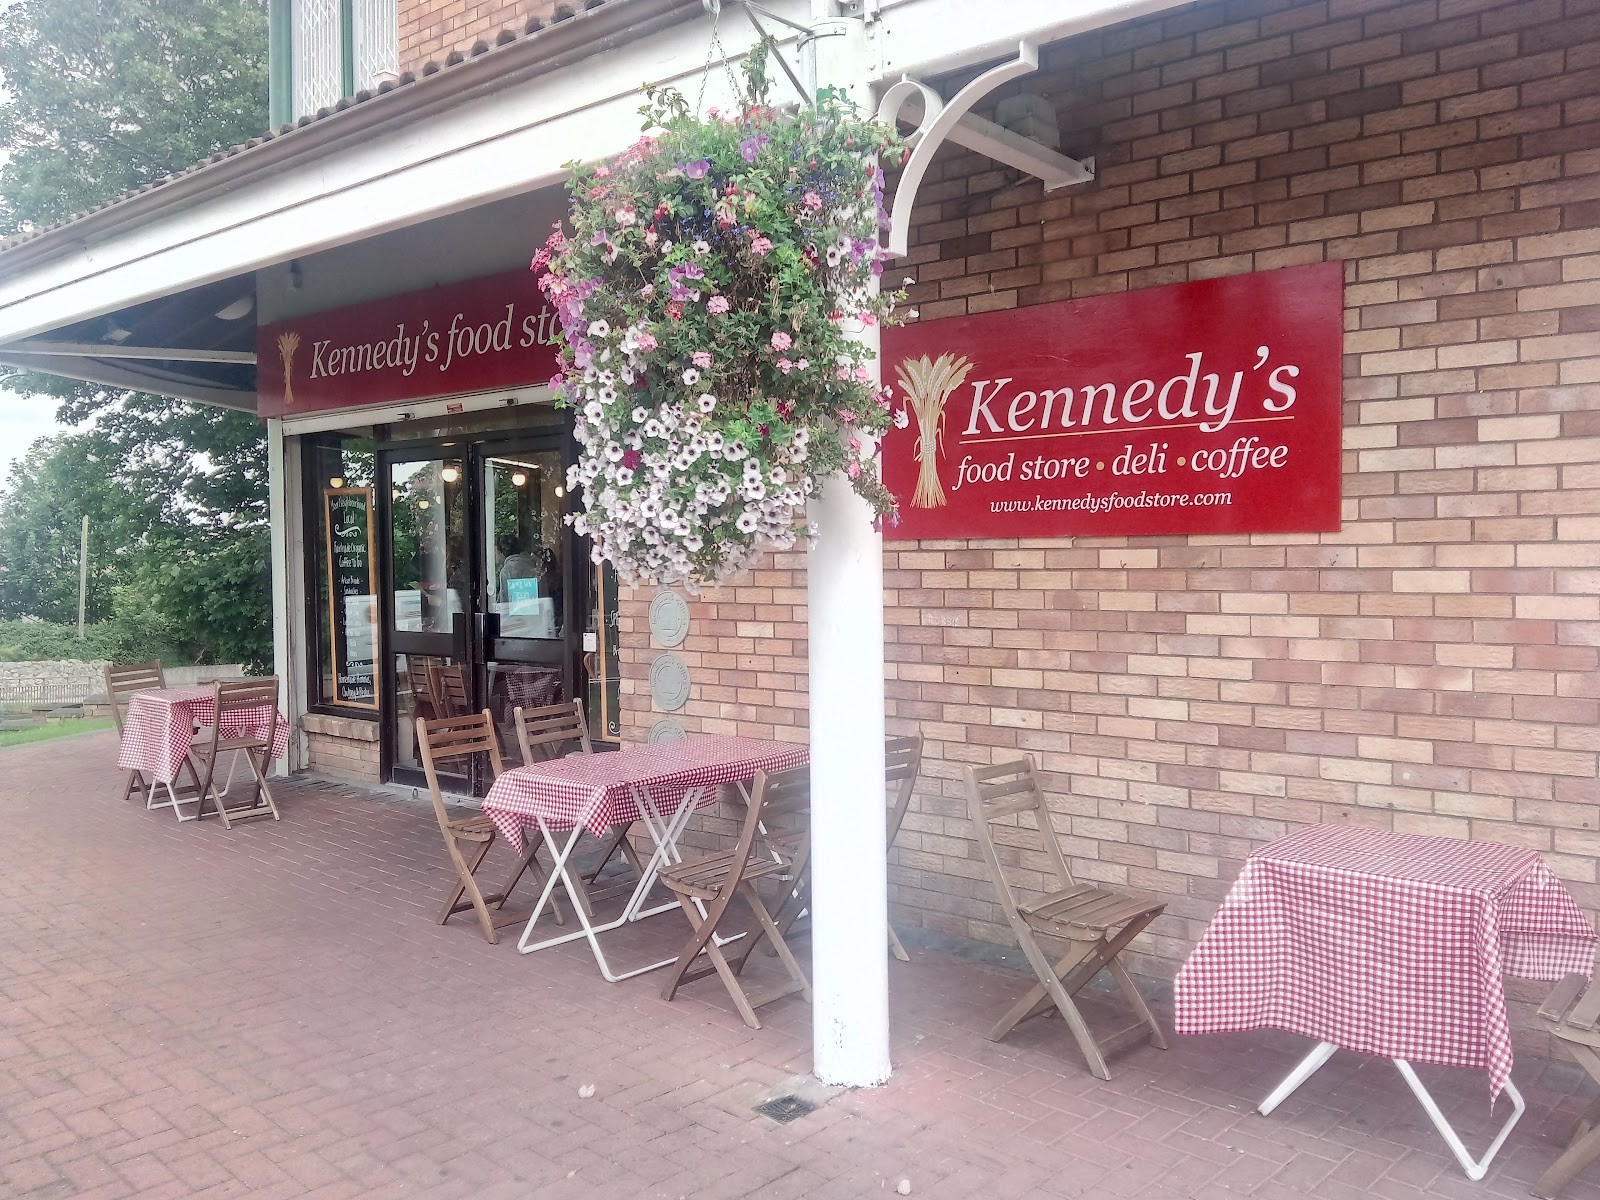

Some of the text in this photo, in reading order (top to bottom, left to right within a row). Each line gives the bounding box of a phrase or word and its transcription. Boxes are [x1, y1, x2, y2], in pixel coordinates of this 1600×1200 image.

[310, 319, 440, 379] Kennedy's
[439, 303, 515, 372] food
[962, 346, 1300, 435] Kennedy's
[952, 436, 1289, 491] food store deli coffee
[343, 511, 355, 524] Local
[989, 490, 1233, 514] www.kennedysfoodstore.com
